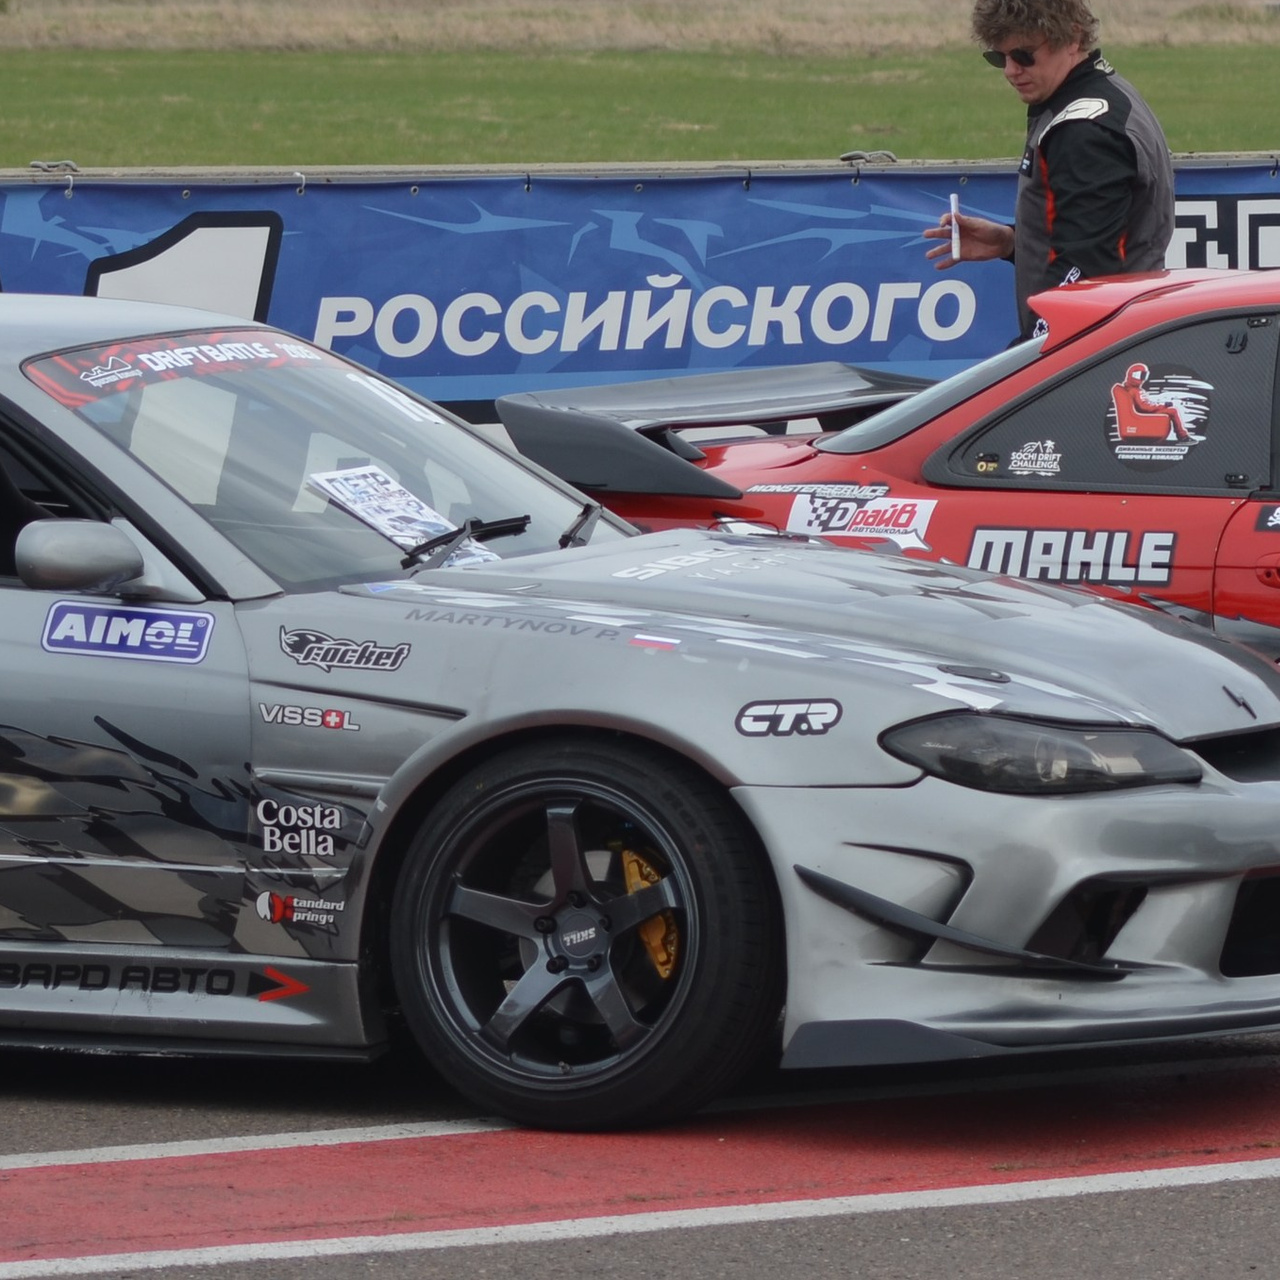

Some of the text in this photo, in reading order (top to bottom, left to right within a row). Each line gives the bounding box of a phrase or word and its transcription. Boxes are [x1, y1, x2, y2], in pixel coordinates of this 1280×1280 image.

[314, 274, 976, 358] РОССИЙСКОГО
[137, 345, 210, 372] DRIFT
[199, 341, 278, 364] BATTLE
[1010, 452, 1062, 462] SOCHI DRIFT
[1011, 460, 1058, 469] CHALLENGE
[967, 529, 1174, 581] MAHLE
[51, 612, 199, 651] AIMOL
[404, 607, 592, 637] MARTYNOV
[257, 798, 341, 829] Costa
[263, 826, 335, 856] Bella
[119, 965, 236, 996] АВТО
